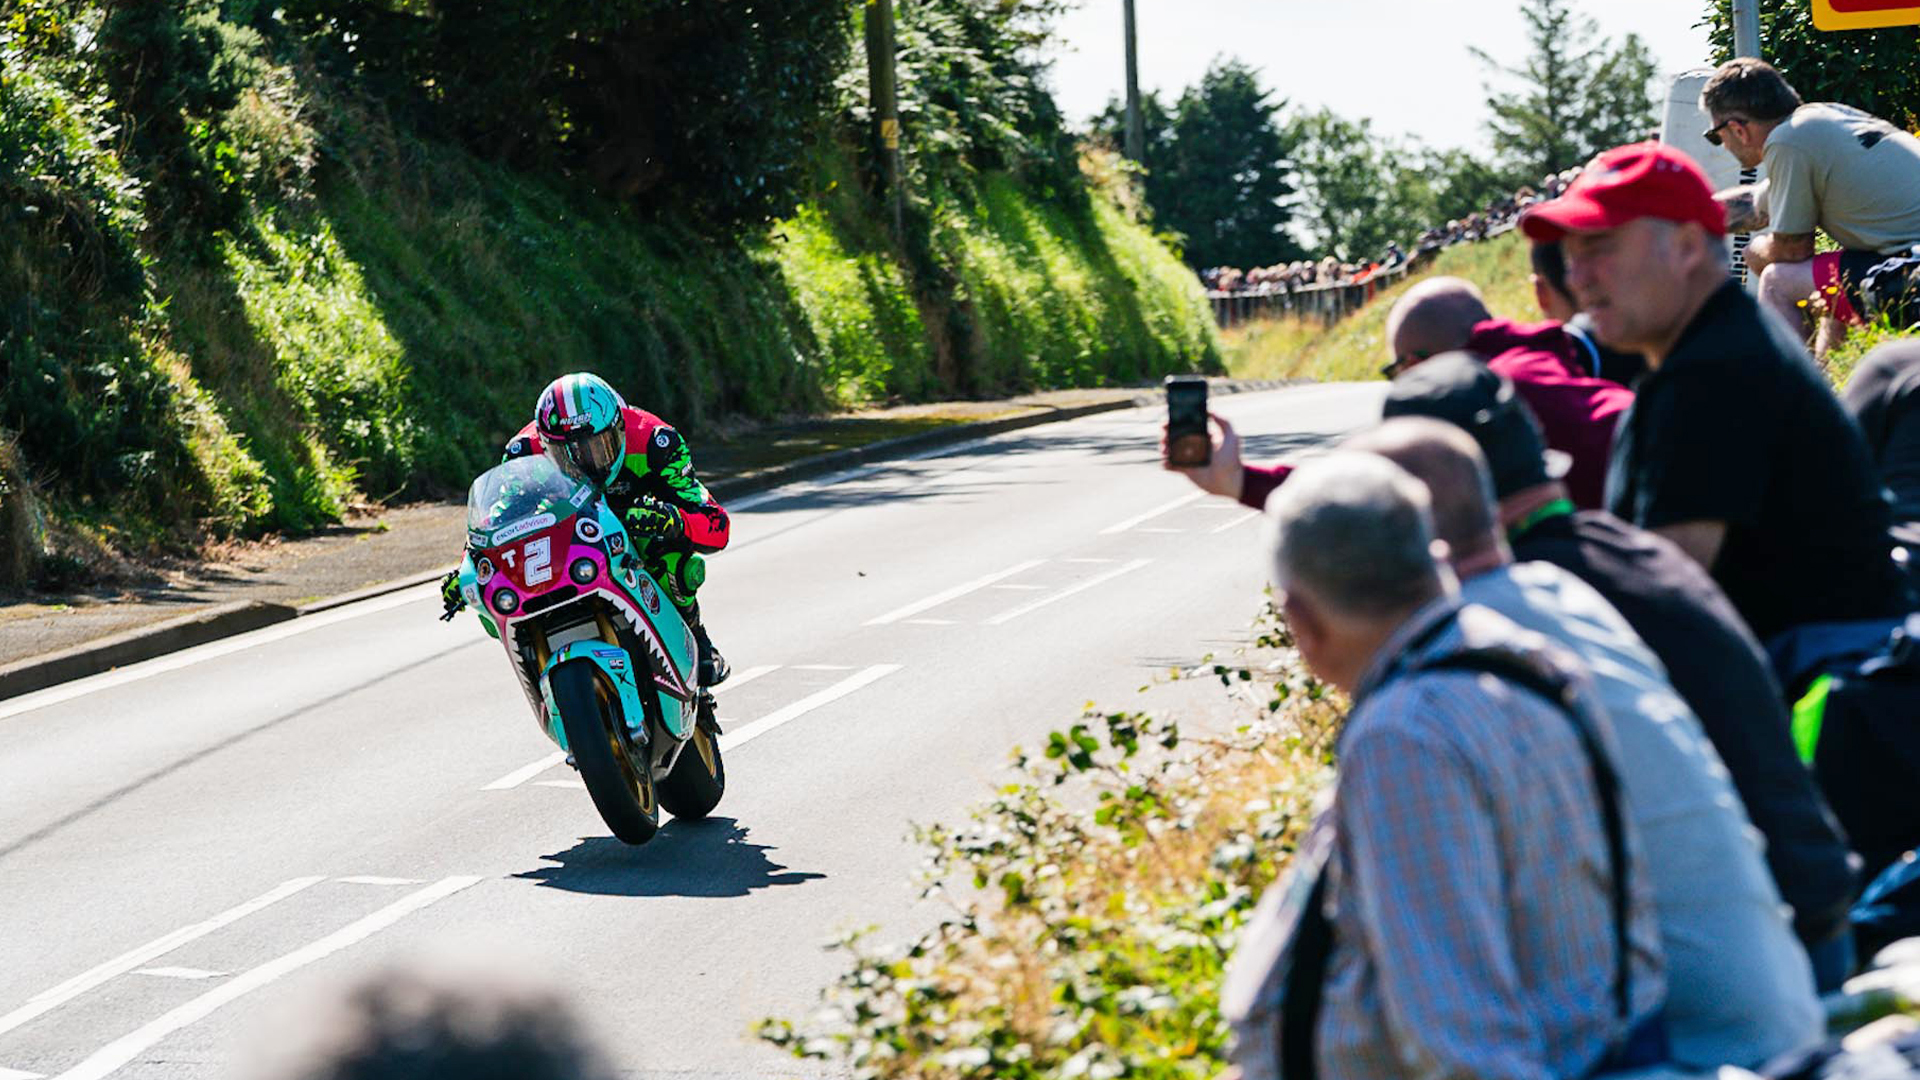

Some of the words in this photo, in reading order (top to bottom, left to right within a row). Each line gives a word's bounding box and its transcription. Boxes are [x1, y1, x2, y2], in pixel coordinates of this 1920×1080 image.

[496, 516, 549, 542] escortadvisor
[501, 549, 516, 568] T
[524, 536, 552, 587] 2
